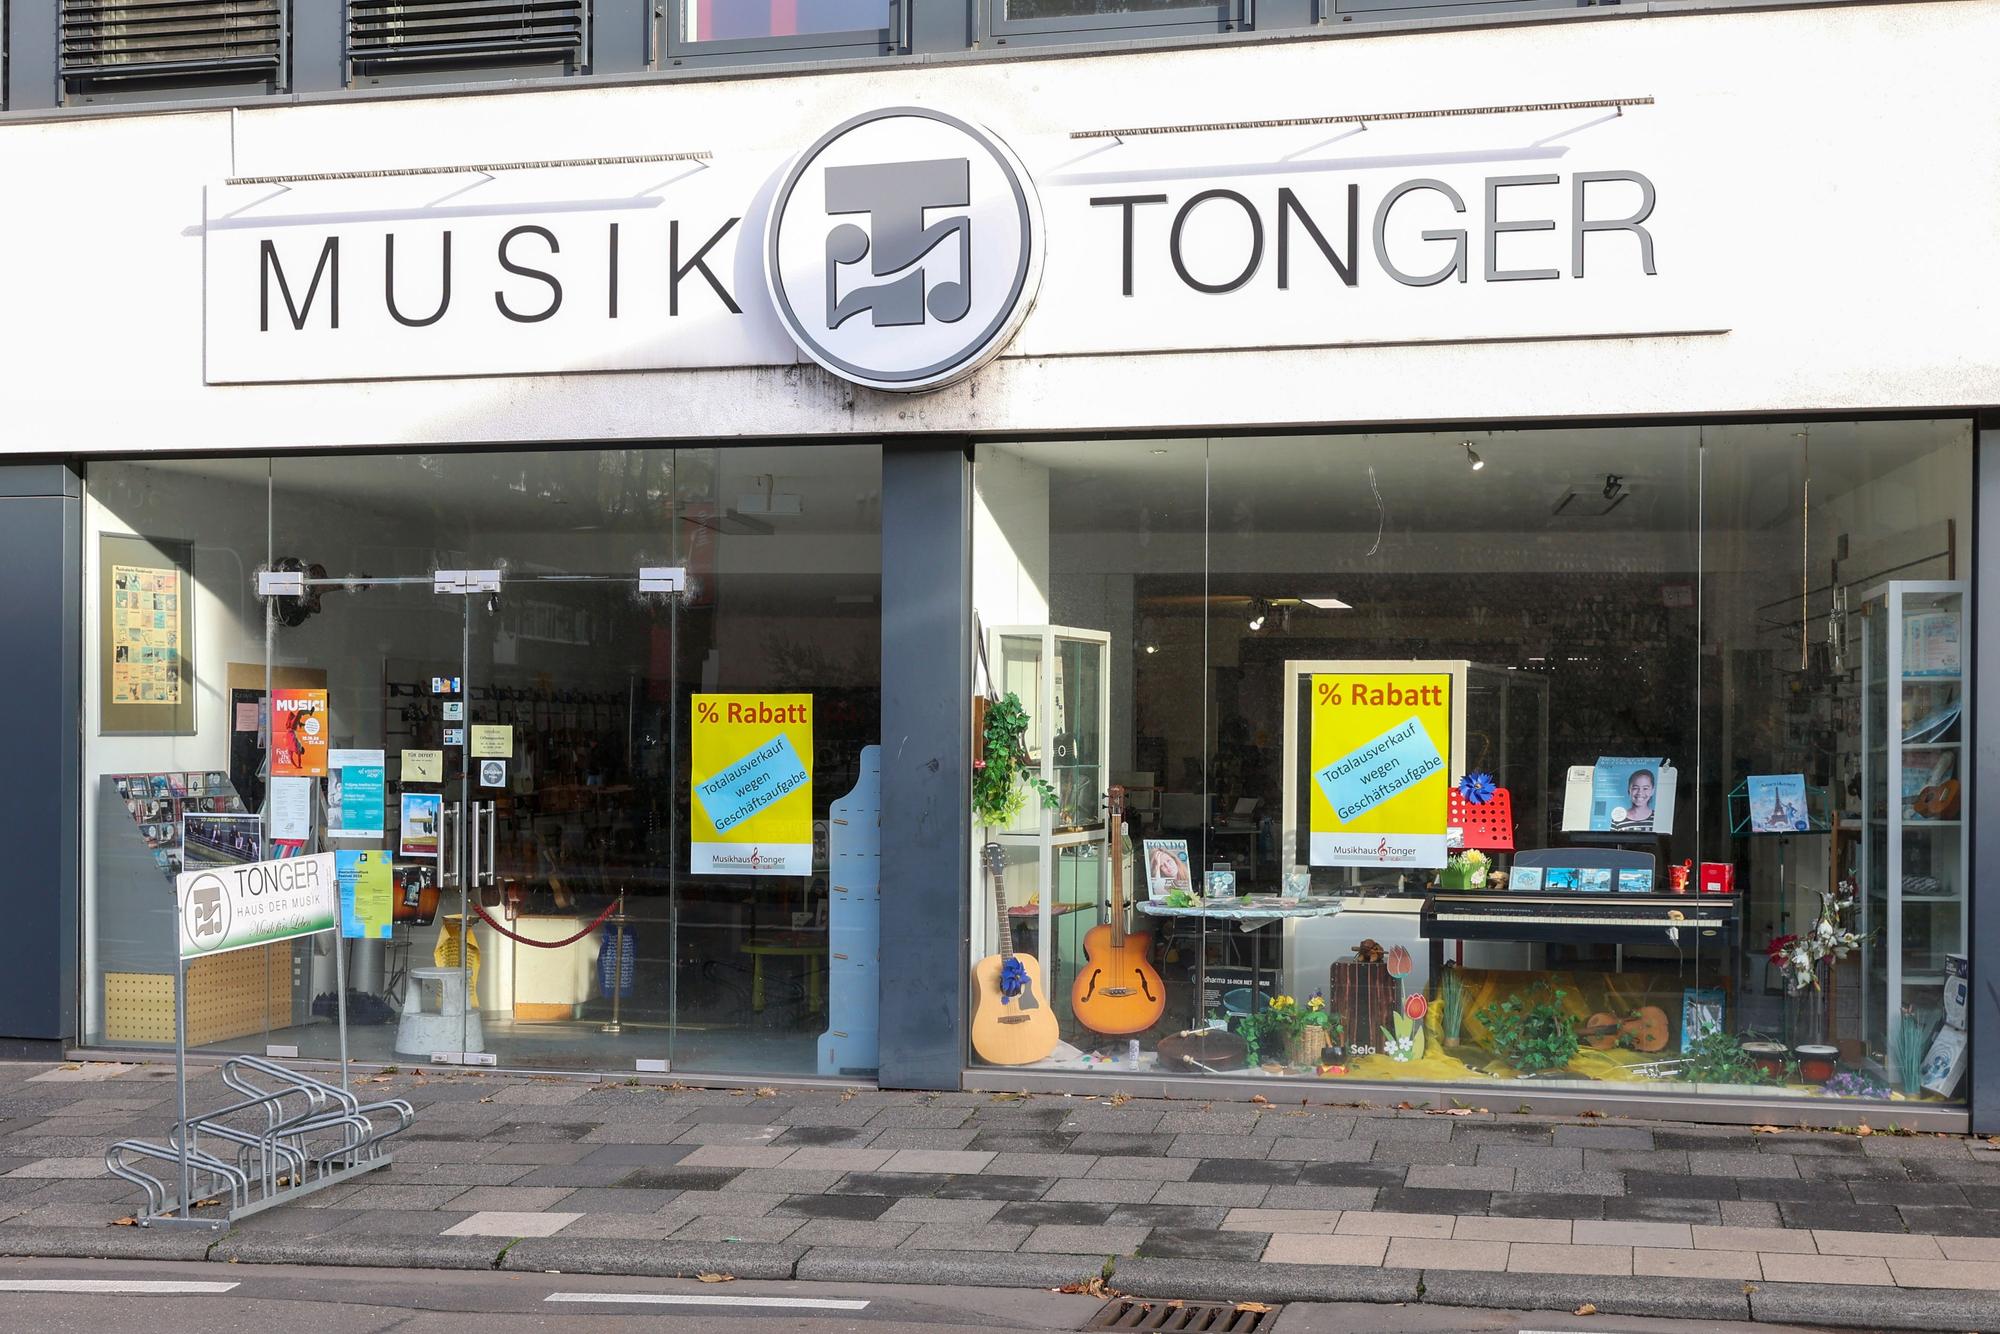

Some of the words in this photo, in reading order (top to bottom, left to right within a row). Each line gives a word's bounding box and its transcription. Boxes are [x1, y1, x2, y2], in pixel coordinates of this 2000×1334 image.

[260, 217, 743, 332] MUSIK
[1089, 170, 1658, 298] TONGER
[276, 699, 325, 712] MUSIC!
[1318, 682, 1342, 706] %
[1352, 682, 1443, 707] Rabatt
[697, 701, 720, 724] %
[728, 701, 808, 725] Rabatt
[1322, 722, 1416, 784] Totalausverkauf
[702, 739, 785, 797] Totalausverkauf
[1359, 756, 1401, 786] wegen
[735, 770, 771, 799] wegen
[1337, 755, 1442, 820] Geschäftsaufgabe
[714, 769, 807, 830] Geschäftsaufgabe
[1146, 840, 1187, 851] RONDO
[1333, 845, 1377, 855] Musikhaus
[1387, 846, 1416, 857] Tonger
[712, 854, 751, 865] Musikhaus
[760, 854, 785, 866] Tonger
[234, 860, 320, 898] TONGER
[237, 905, 265, 918] HAUS
[269, 901, 289, 913] DER
[292, 895, 321, 909] MUSIK
[1350, 1044, 1376, 1055] Sela
